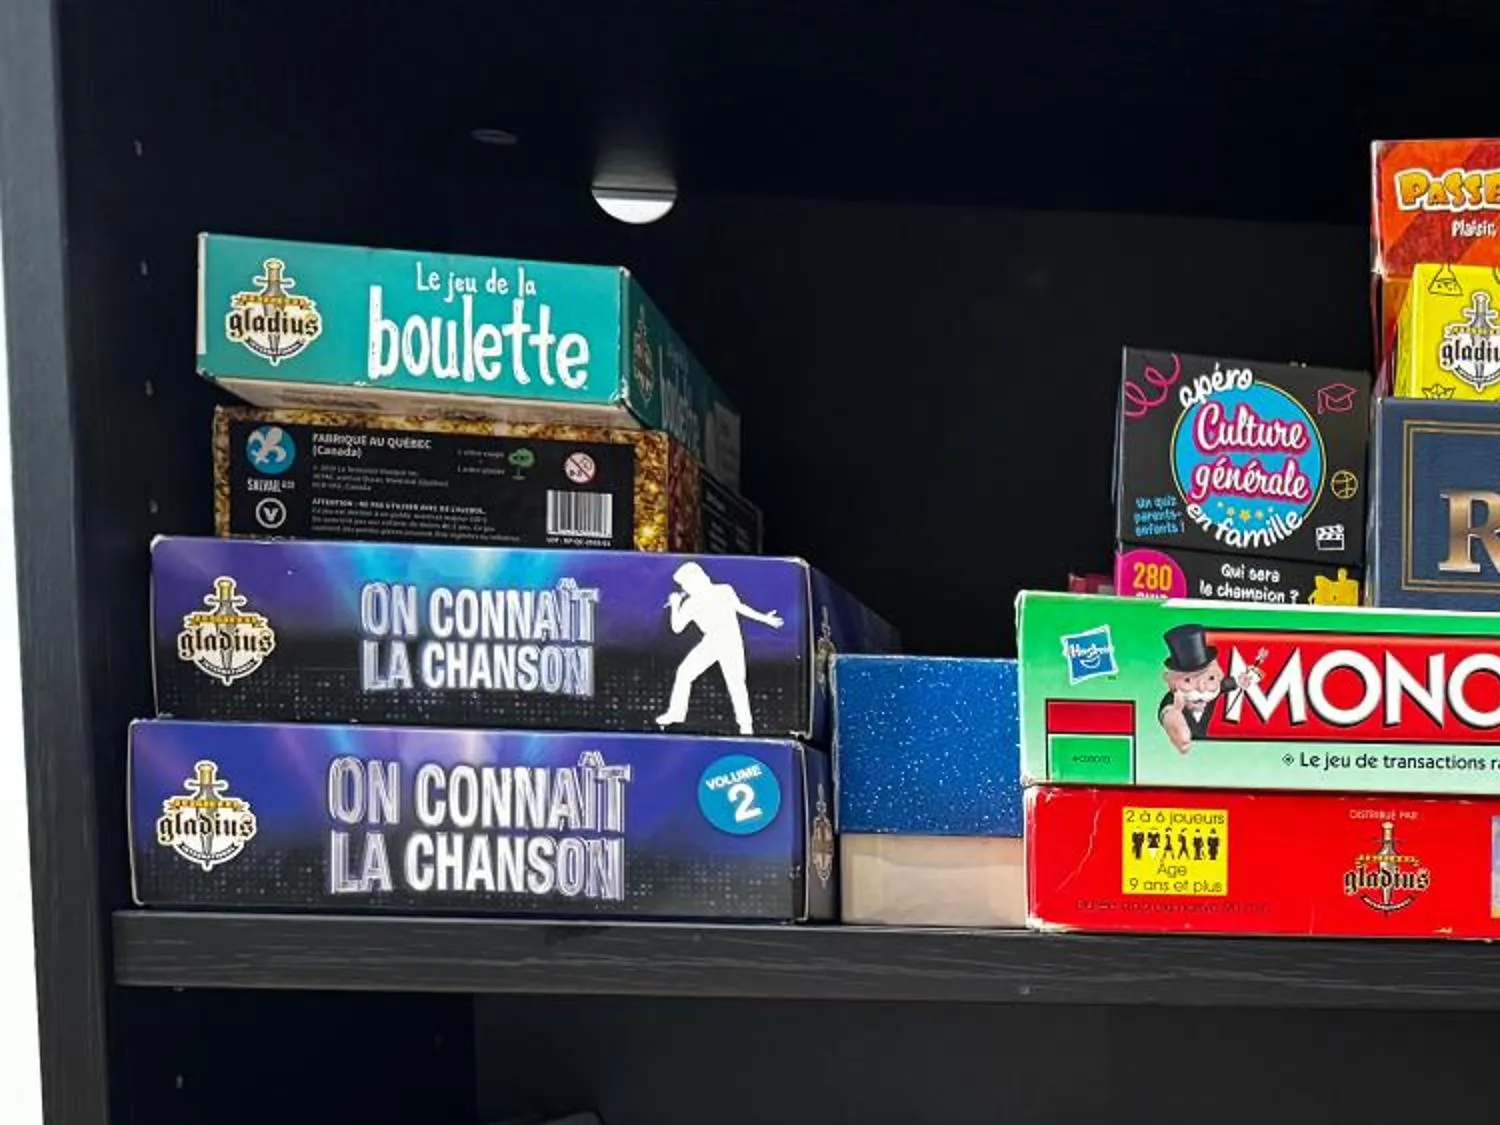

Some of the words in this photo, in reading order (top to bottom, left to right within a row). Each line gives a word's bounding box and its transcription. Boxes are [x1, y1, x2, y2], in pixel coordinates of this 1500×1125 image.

[416, 261, 441, 290] Le
[443, 267, 478, 304] jeu
[485, 266, 509, 296] de
[517, 266, 537, 297] la
[227, 308, 320, 337] gladius
[367, 285, 590, 390] boulette
[1179, 362, 1254, 409] apéro
[369, 436, 385, 449] AU
[1196, 402, 1308, 451] Culture
[1189, 456, 1310, 501] générale
[1187, 503, 1211, 532] en
[1216, 510, 1303, 548] famille
[1132, 561, 1174, 592] 280
[1216, 580, 1286, 605] champion
[1221, 563, 1246, 581] Qui
[1250, 567, 1281, 583] sera
[360, 581, 420, 637] ON
[427, 577, 600, 643] CONNAÎT
[178, 626, 275, 660] gladius
[361, 639, 416, 692] LA
[420, 641, 596, 698] CHANSON
[705, 762, 762, 791] VOLUME
[1300, 752, 1321, 769] Le
[1323, 752, 1352, 772] jeu
[1355, 752, 1379, 769] de
[1383, 754, 1487, 772] transactions
[327, 755, 401, 827] ON
[414, 749, 632, 835] CONNAÎT
[726, 783, 762, 823] 2
[156, 803, 257, 842] gladius
[1125, 809, 1136, 824] 2
[1139, 808, 1151, 825] à
[1155, 810, 1166, 825] 6
[328, 831, 393, 895] LA
[402, 831, 626, 901] CHANSON
[1343, 866, 1431, 894] gladius
[1129, 878, 1139, 893] 9
[1143, 880, 1171, 895] ans
[1173, 879, 1189, 893] et
[1192, 878, 1224, 895] plus
